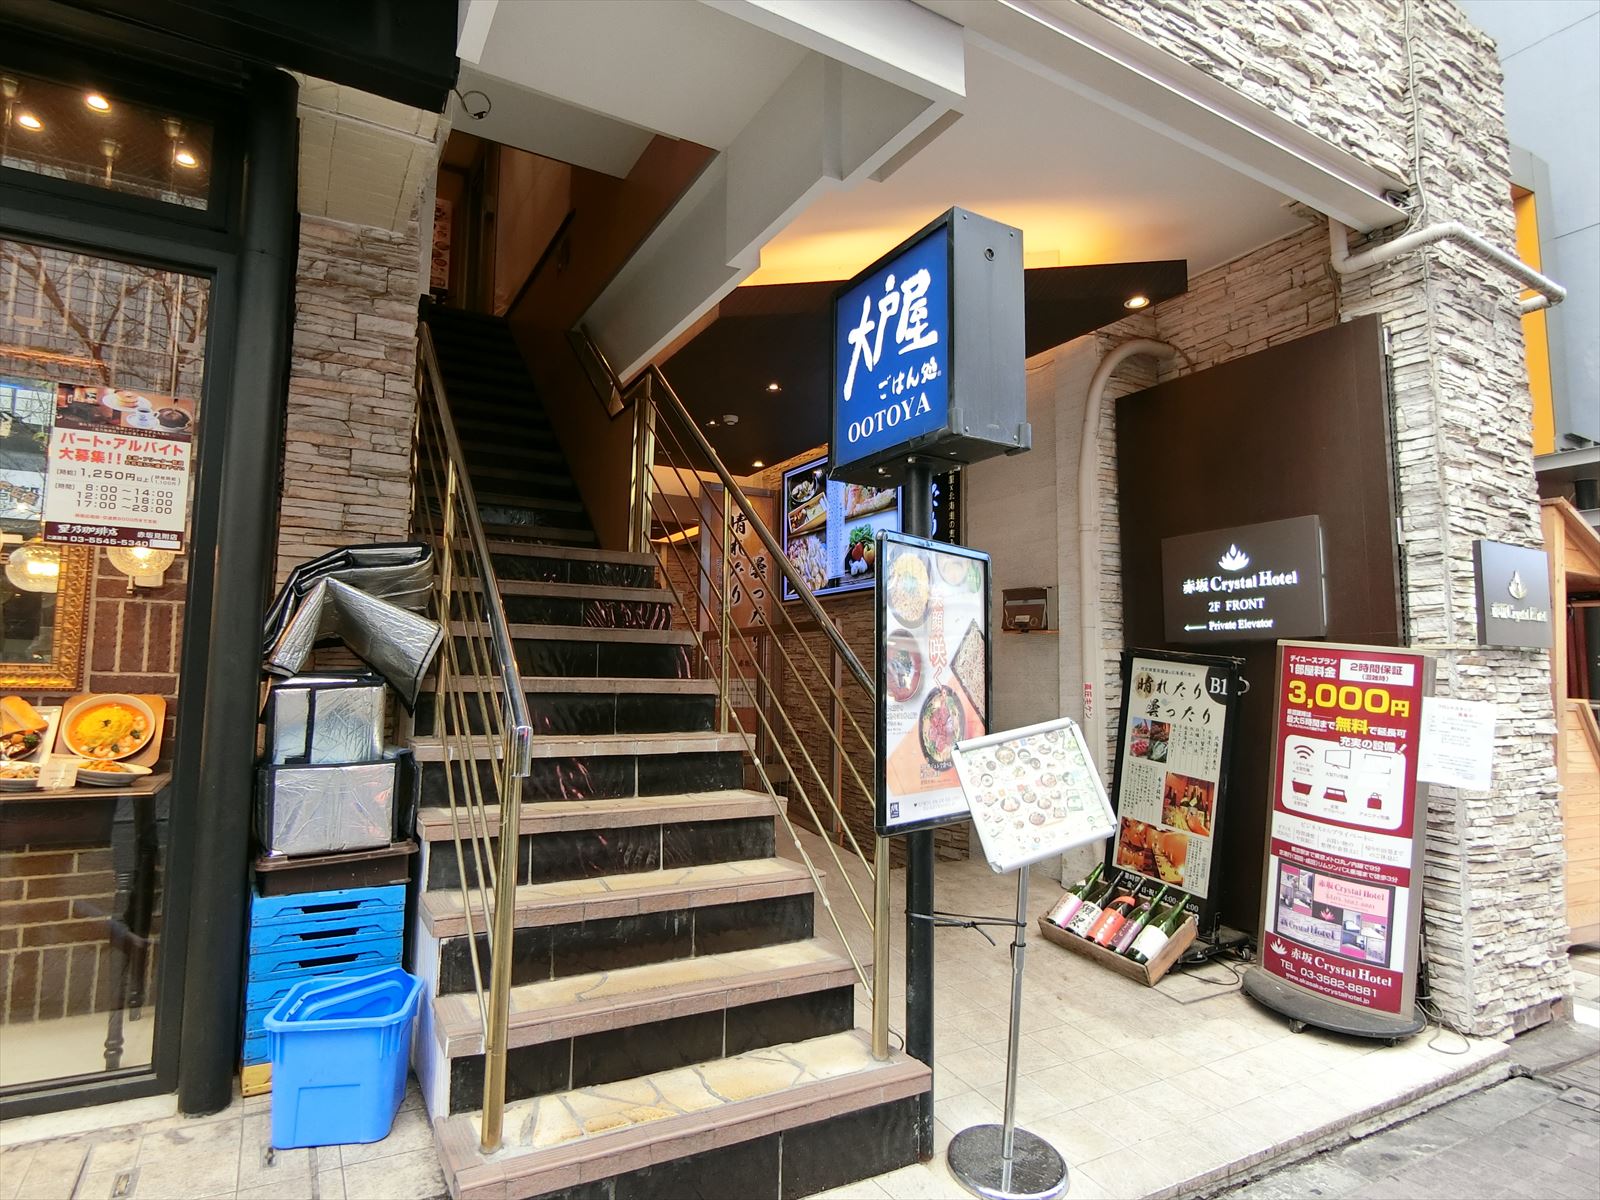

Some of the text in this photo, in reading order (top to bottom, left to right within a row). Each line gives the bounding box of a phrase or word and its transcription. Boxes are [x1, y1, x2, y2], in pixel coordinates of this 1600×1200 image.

[844, 268, 938, 401] 大戸屋
[878, 356, 938, 400] ごはん処
[847, 391, 931, 443] OOTOYA
[61, 432, 183, 456] パート・アルバイト
[1182, 570, 1298, 594] 赤坂 Crystal Hotel
[1208, 597, 1265, 613] 2F FRONT
[1208, 618, 1274, 631] Private Elevator
[1350, 662, 1403, 676] 2時間保証
[1137, 674, 1202, 700] 晴れたり
[1209, 677, 1228, 695] B1
[1288, 679, 1410, 717] 3,000円
[1334, 881, 1361, 897] Crystal
[1280, 958, 1377, 998] TEL 03-3582-8881
[1291, 947, 1392, 987] 赤坂 Crystal Hotel
